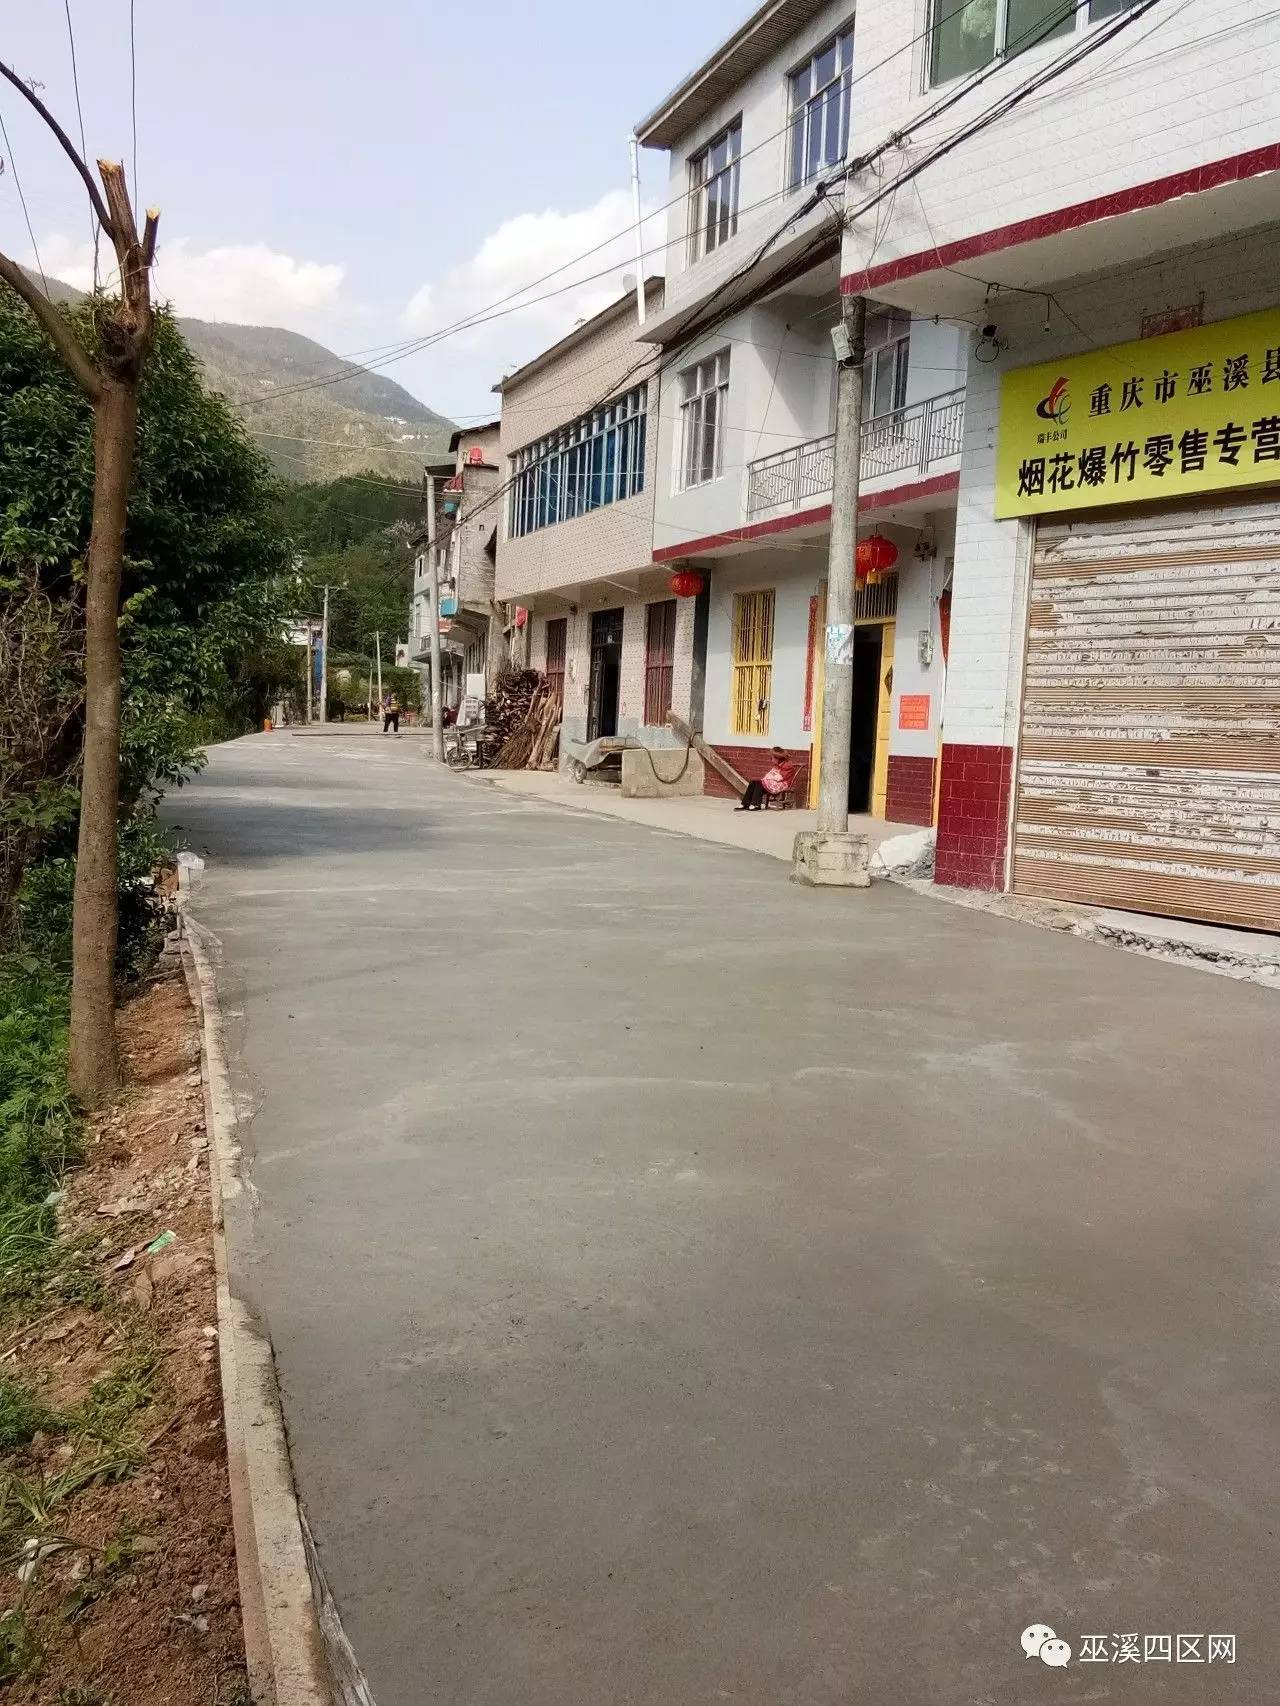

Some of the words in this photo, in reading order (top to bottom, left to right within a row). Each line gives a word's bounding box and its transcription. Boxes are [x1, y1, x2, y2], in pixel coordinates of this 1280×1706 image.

[1088, 347, 1280, 418] 重庆市巫溪县
[1017, 415, 1280, 498] 烟花爆竹零售专营
